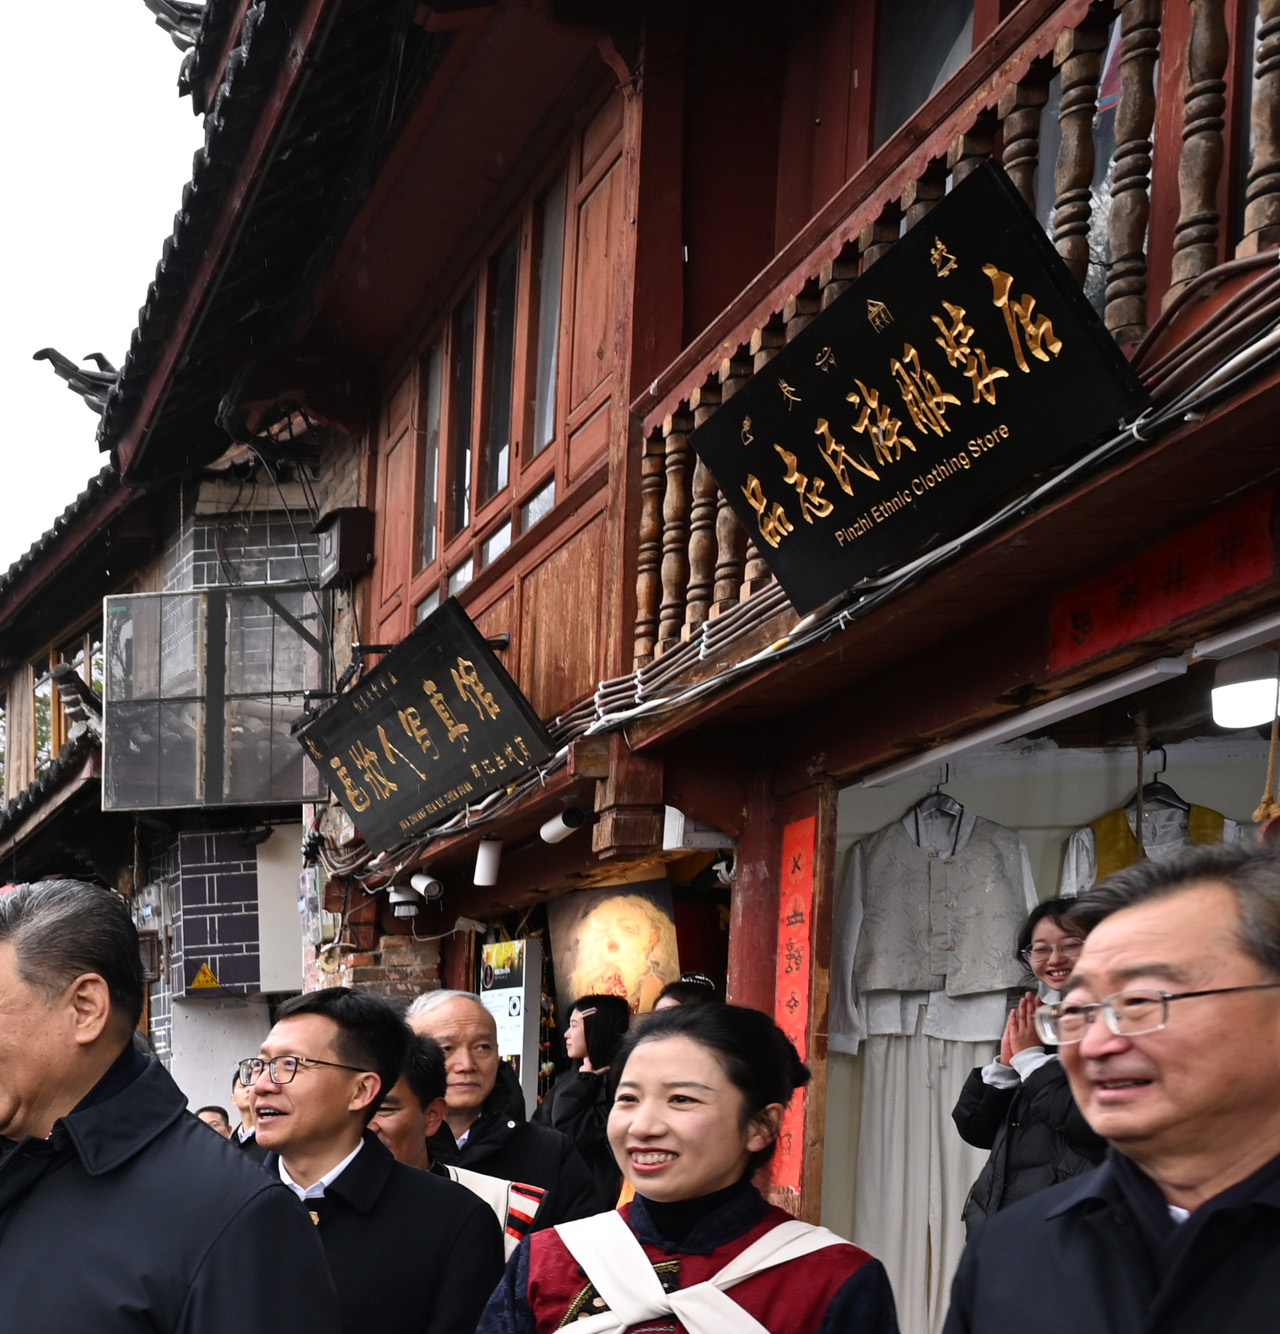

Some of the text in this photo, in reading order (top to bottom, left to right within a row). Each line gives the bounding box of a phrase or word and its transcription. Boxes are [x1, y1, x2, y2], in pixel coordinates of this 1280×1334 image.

[741, 264, 1063, 549] 品志民族服装店
[834, 424, 1010, 547] Pinzhi Ethnic Clothing Store
